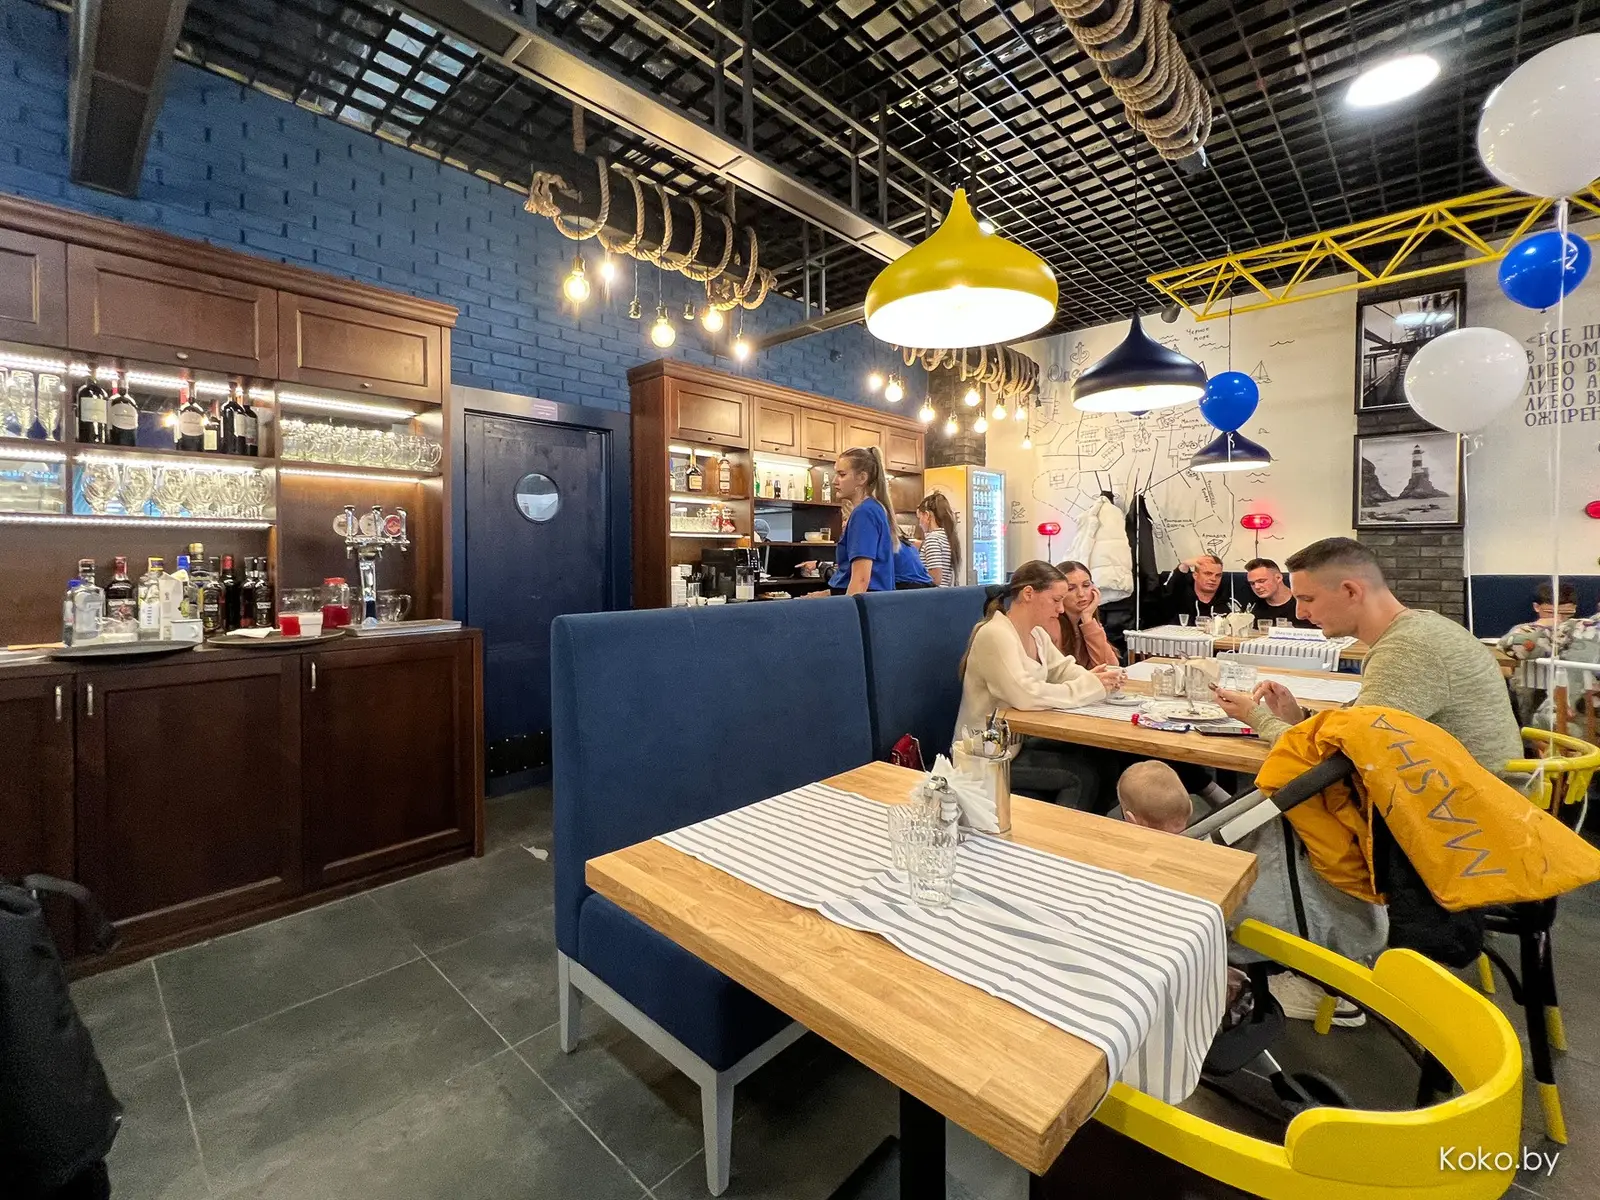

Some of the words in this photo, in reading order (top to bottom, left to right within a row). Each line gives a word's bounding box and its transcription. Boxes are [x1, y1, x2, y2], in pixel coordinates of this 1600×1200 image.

[1582, 324, 1600, 340] П
[1525, 350, 1535, 364] В
[1546, 341, 1599, 362] ЭТОМ
[1526, 360, 1575, 380] ЛИБО
[1585, 357, 1600, 373] В
[1525, 376, 1575, 396] ЛИБО
[1525, 392, 1575, 412] ЛИБО
[1585, 390, 1600, 406] В
[1370, 714, 1507, 878] MASHA
